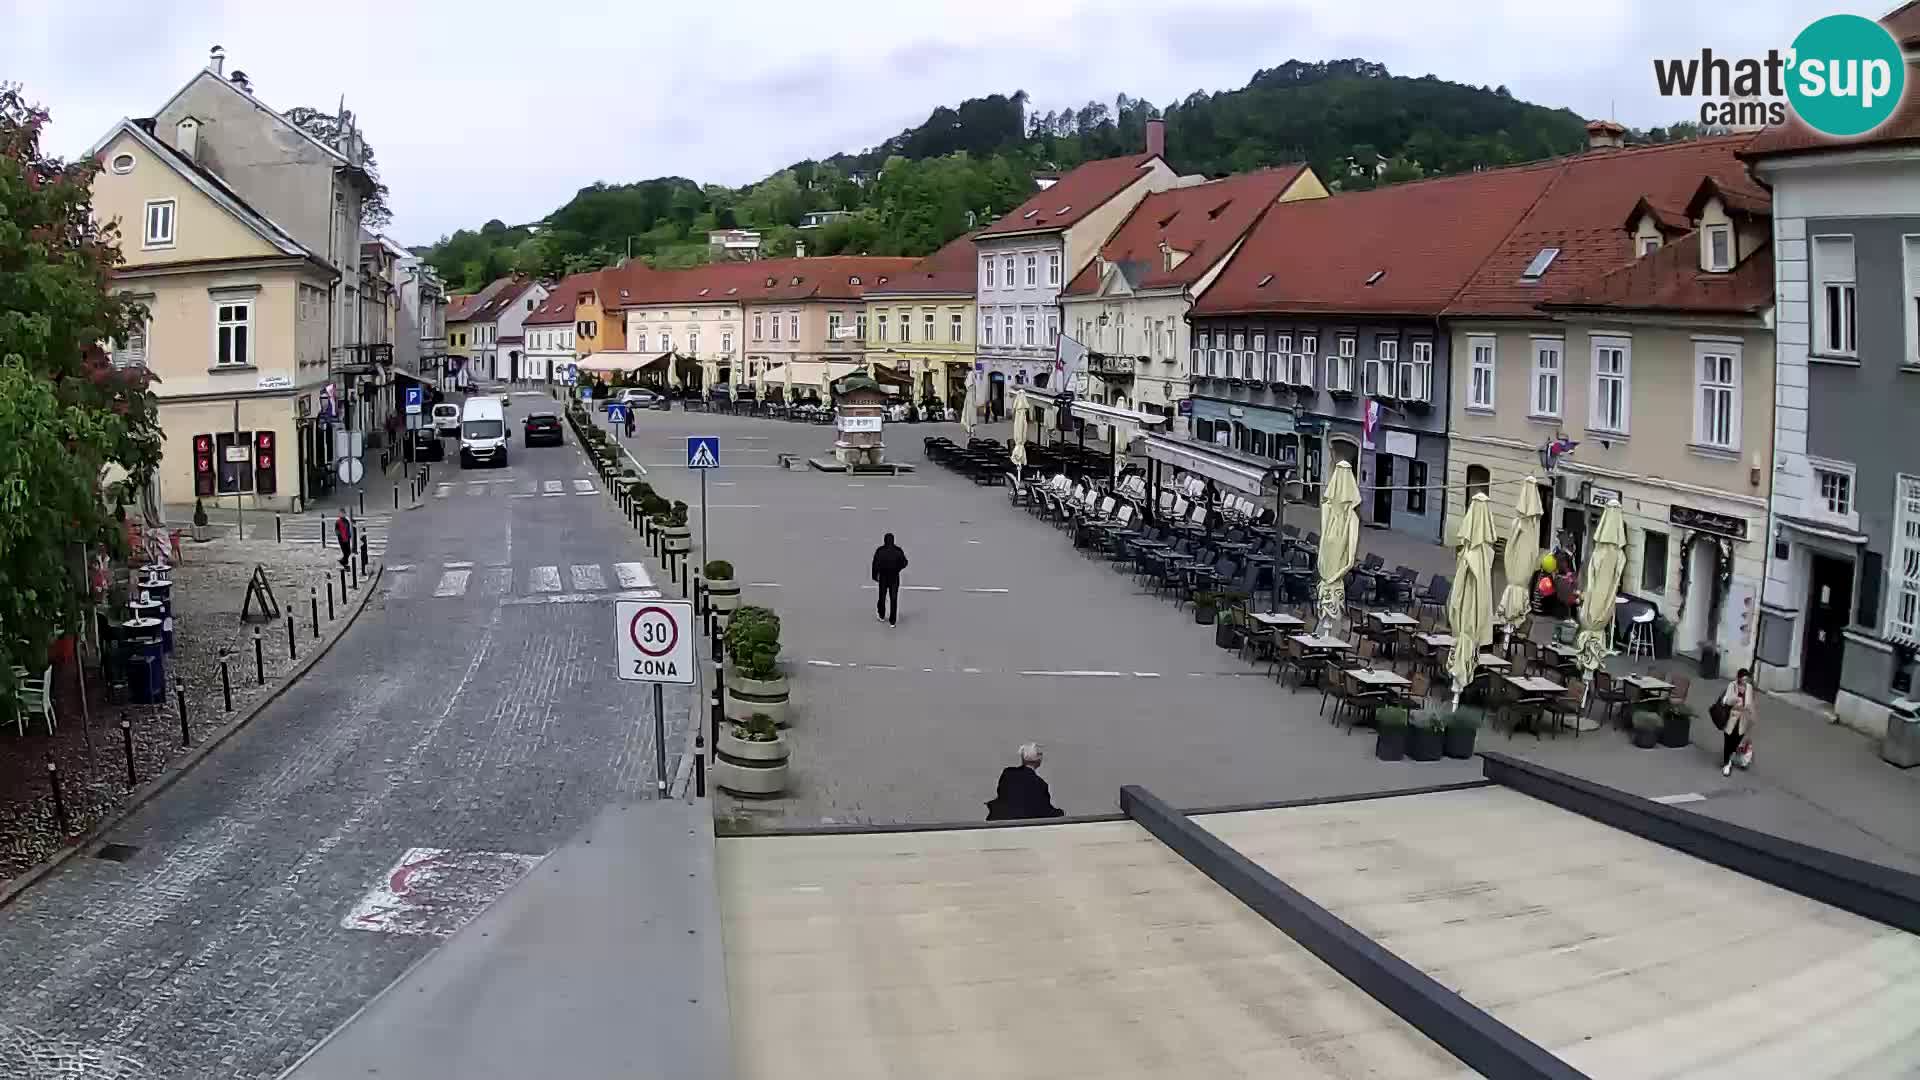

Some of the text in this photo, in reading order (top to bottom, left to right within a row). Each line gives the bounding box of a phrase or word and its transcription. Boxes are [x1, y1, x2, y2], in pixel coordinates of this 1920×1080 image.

[410, 391, 418, 403] P
[643, 622, 667, 643] 30
[633, 659, 678, 676] ZONA
